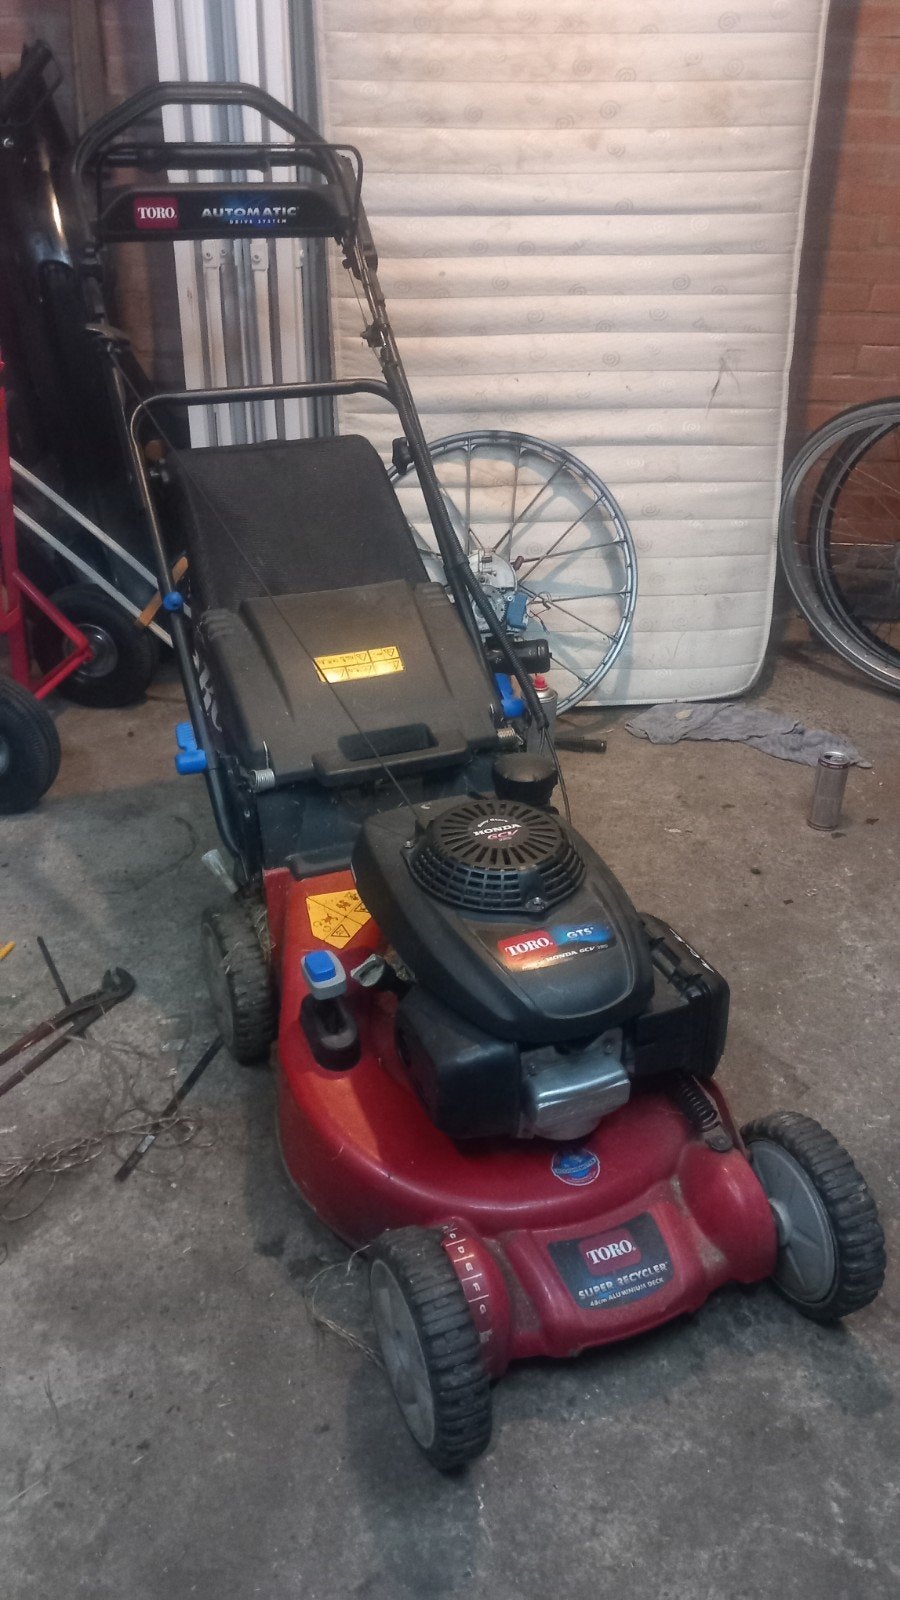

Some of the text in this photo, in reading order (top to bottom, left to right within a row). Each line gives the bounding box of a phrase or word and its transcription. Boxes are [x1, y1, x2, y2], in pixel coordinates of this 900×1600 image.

[137, 206, 175, 219] TORO
[201, 207, 297, 217] AUTOMATIC
[473, 823, 522, 836] HONDA
[566, 927, 592, 939] GTS
[504, 937, 550, 957] TORO
[586, 1239, 633, 1265] TORO
[578, 1262, 668, 1299] SUPER RECYCLER
